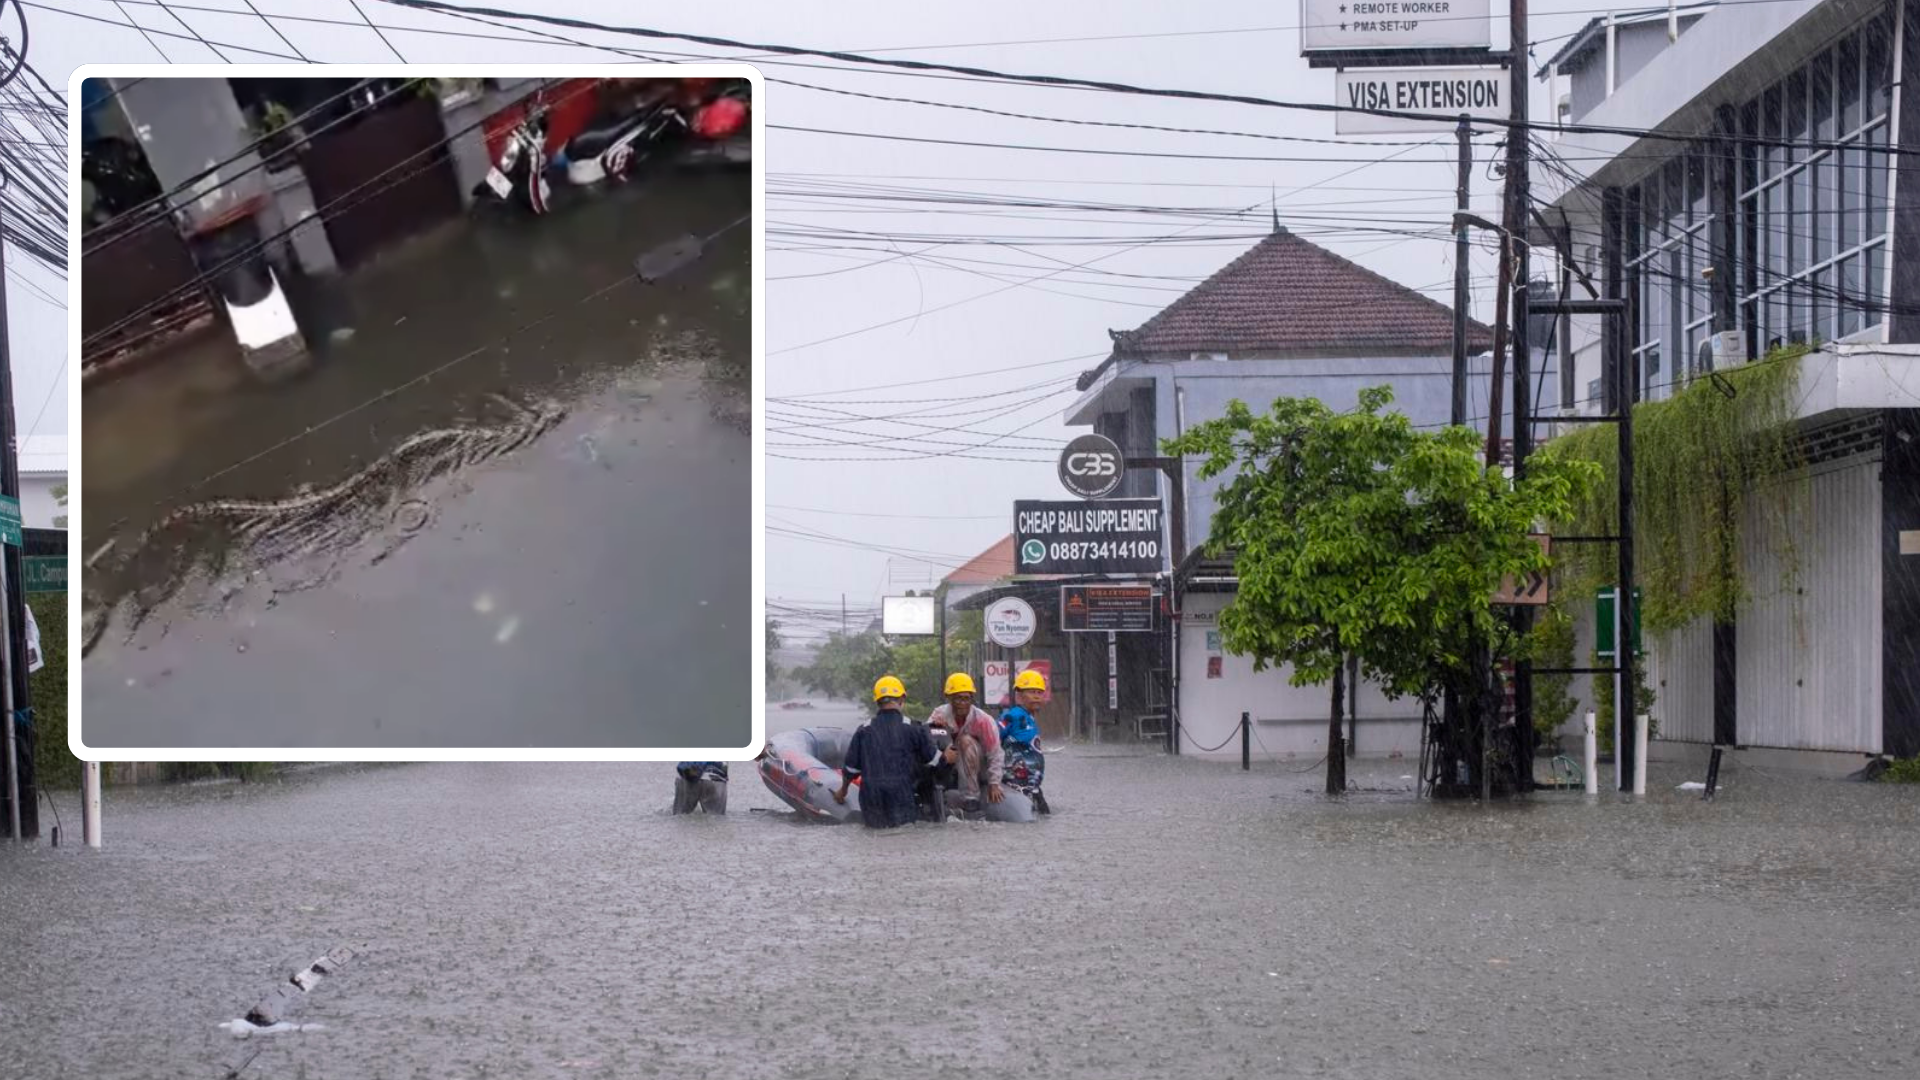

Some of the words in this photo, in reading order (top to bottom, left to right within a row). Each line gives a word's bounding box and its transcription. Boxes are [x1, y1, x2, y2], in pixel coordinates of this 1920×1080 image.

[1353, 3, 1398, 14] REMOTE
[1401, 2, 1449, 13] WORKER
[1353, 21, 1377, 32] PMA
[1379, 21, 1418, 31] SET-UP
[1348, 81, 1390, 110] VISA
[1396, 79, 1499, 108] EXTENSION
[1067, 453, 1116, 475] CBS
[1019, 511, 1056, 534] CHEAP
[1058, 510, 1083, 533] BALI
[1086, 509, 1158, 533] SUPPLEMENT
[1050, 541, 1157, 560] 08873414100
